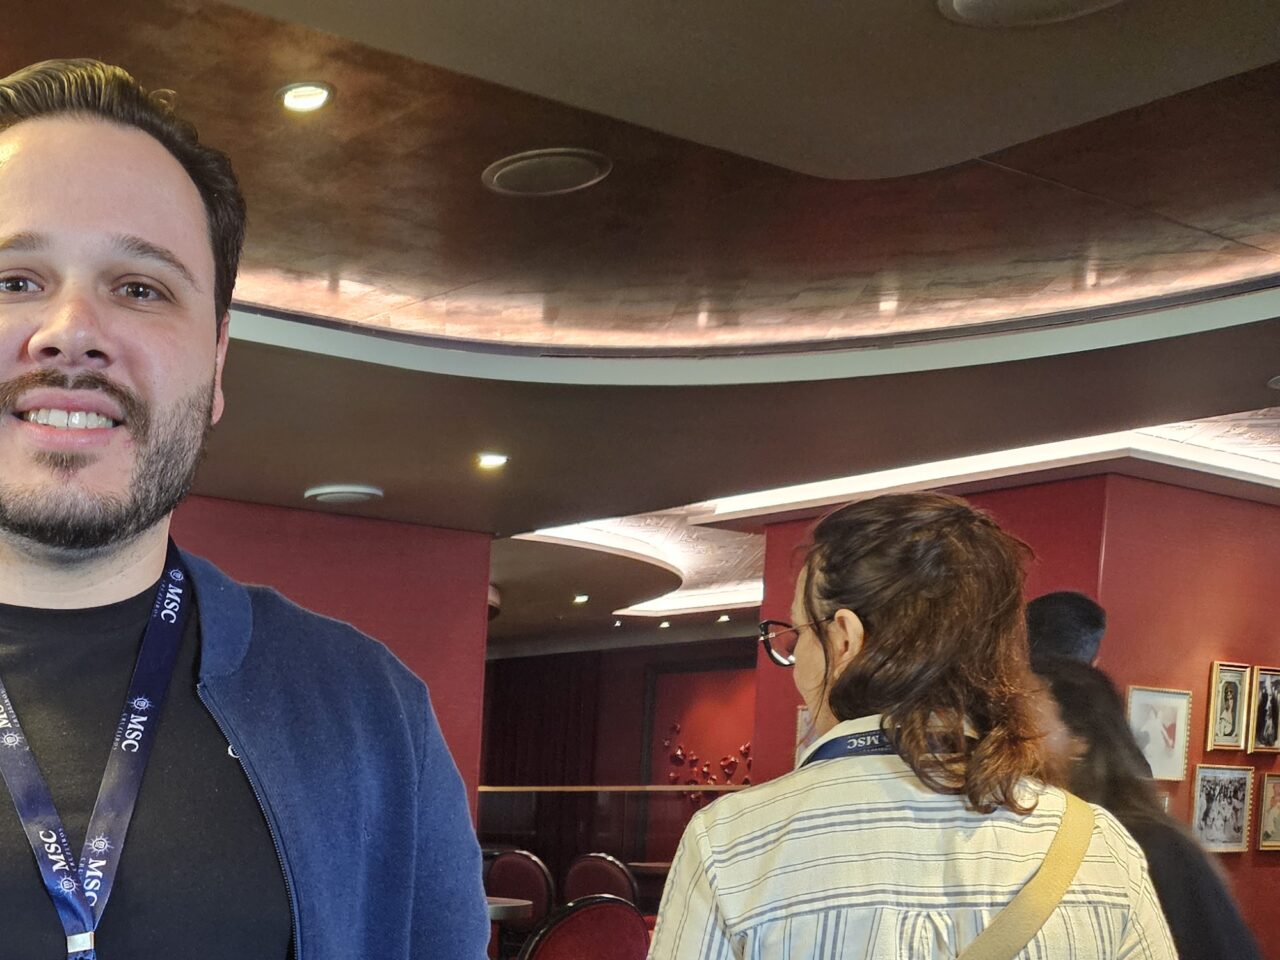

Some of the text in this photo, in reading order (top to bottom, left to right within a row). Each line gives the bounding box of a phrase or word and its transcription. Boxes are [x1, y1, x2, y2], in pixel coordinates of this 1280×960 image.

[160, 583, 183, 624] MSC
[121, 713, 148, 753] MSC
[846, 735, 880, 749] MSC
[38, 829, 70, 873] MSC
[83, 857, 107, 907] MSC
